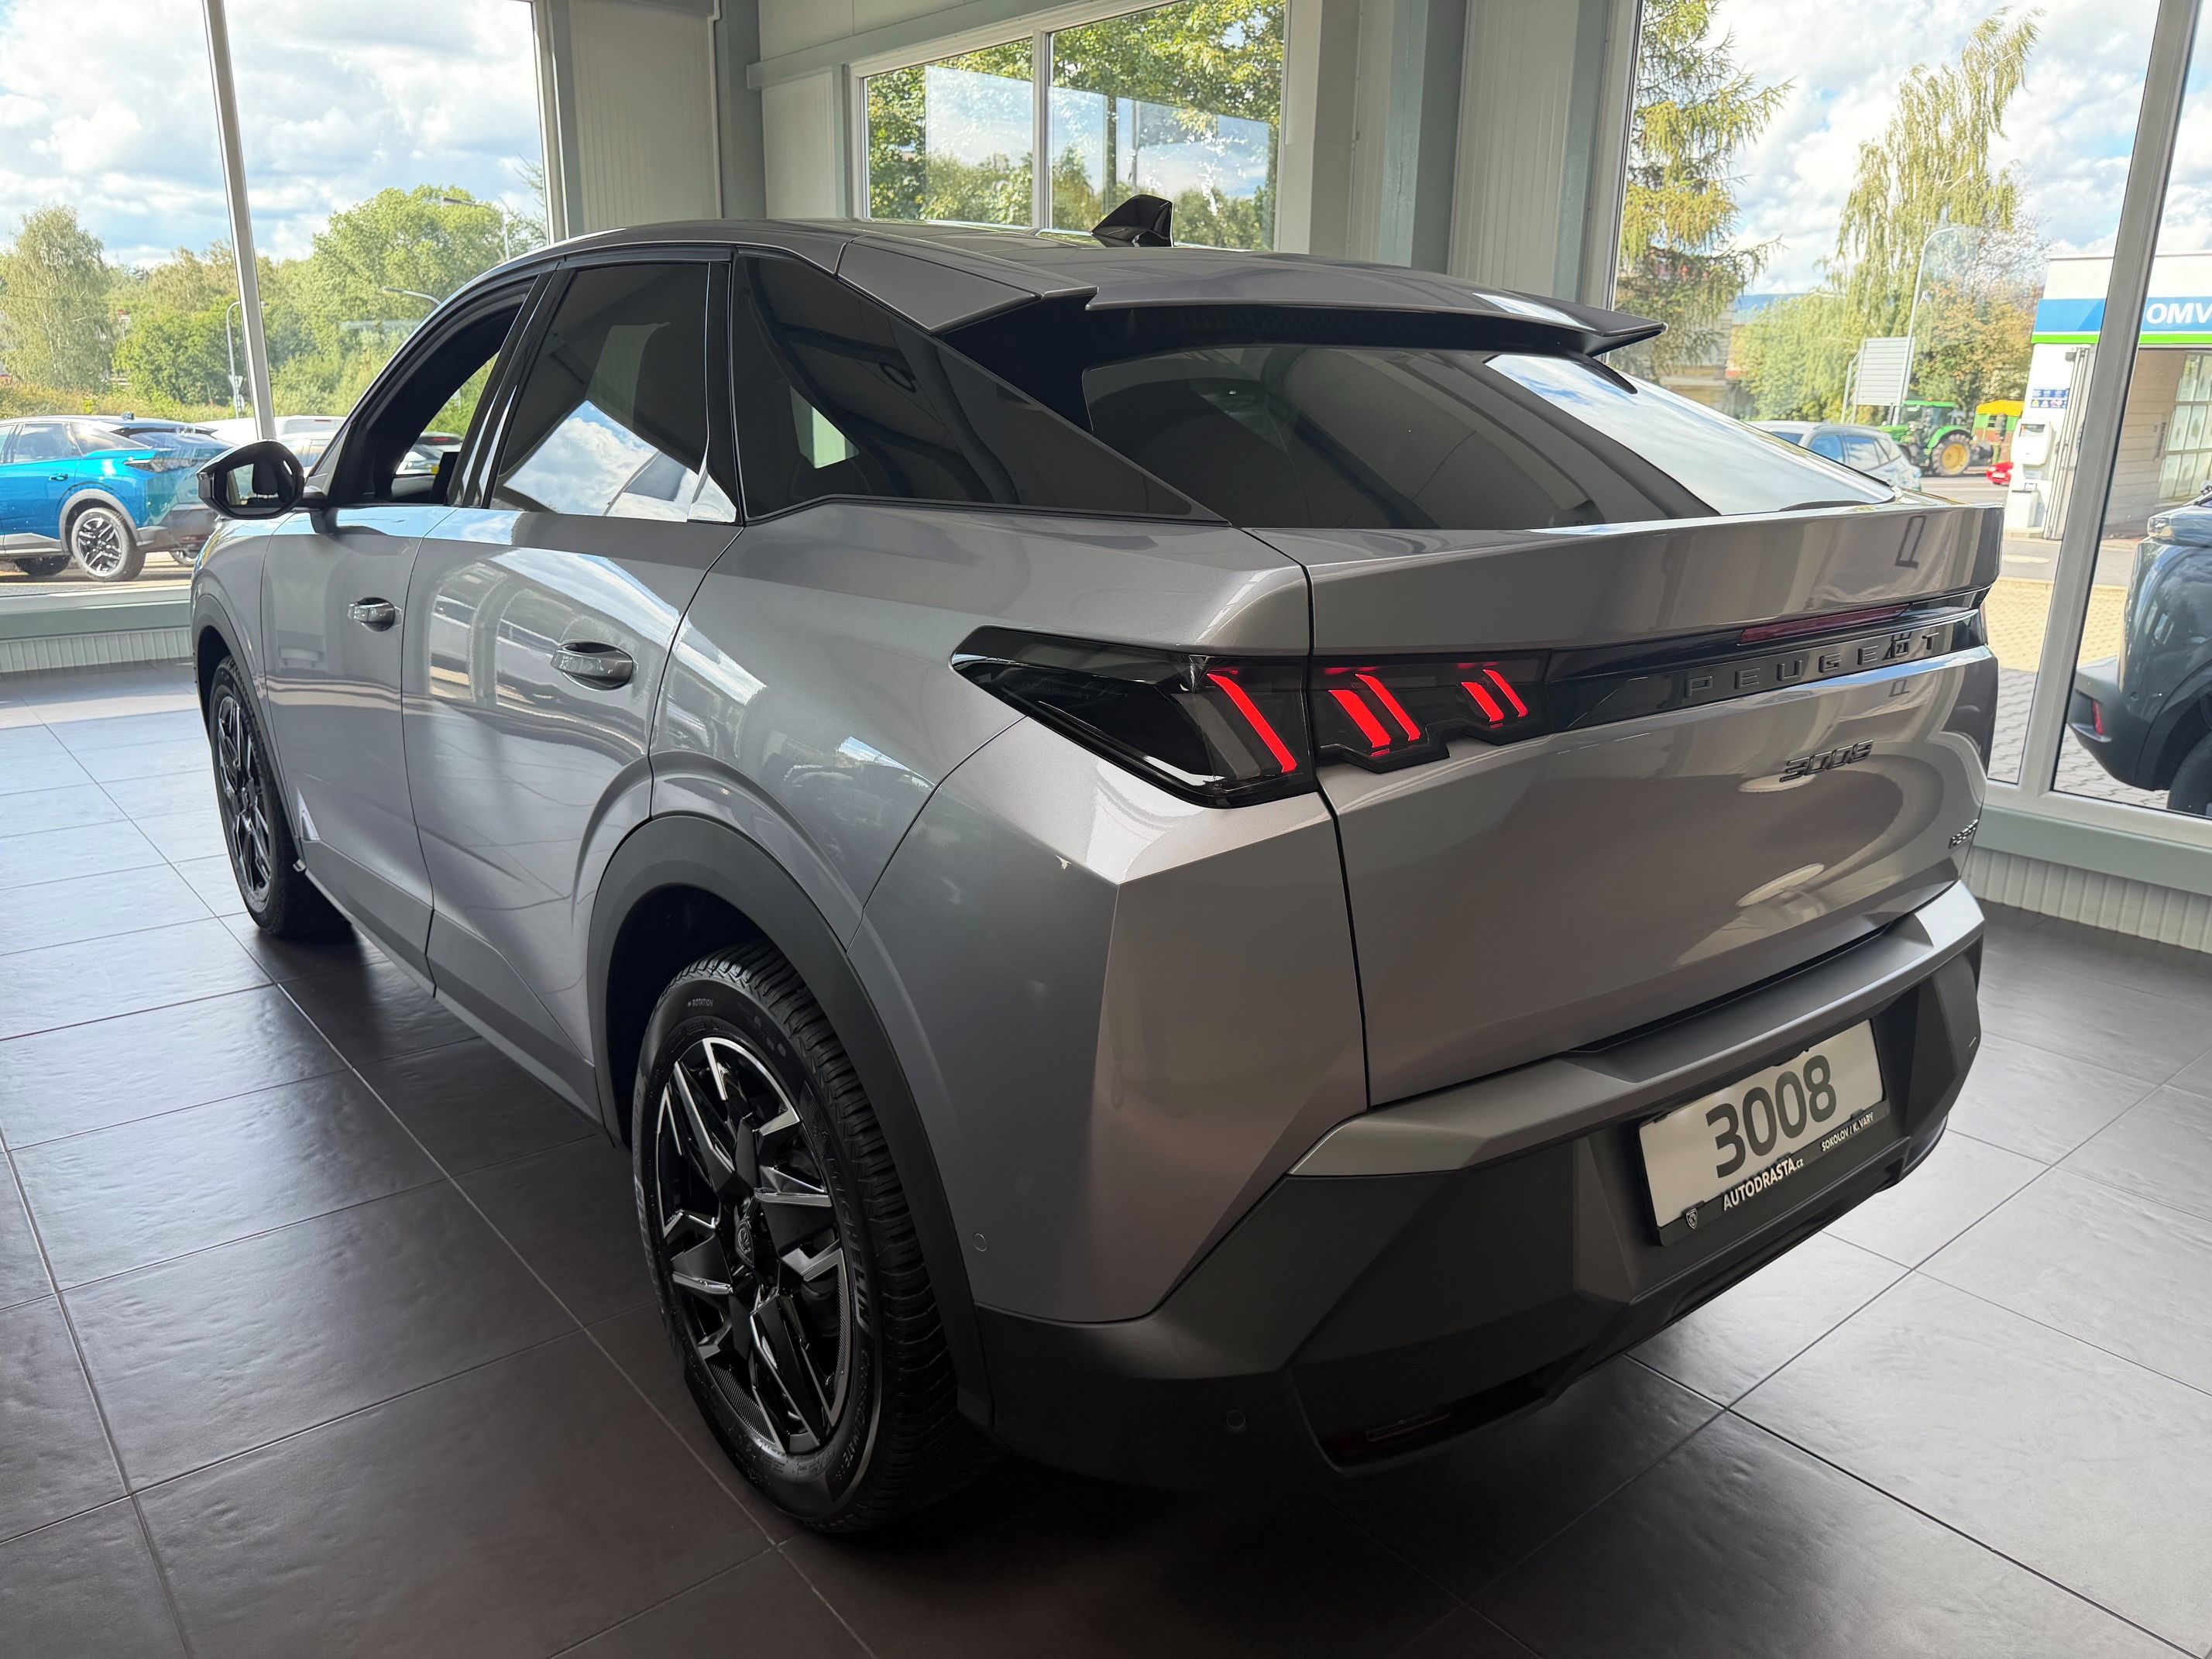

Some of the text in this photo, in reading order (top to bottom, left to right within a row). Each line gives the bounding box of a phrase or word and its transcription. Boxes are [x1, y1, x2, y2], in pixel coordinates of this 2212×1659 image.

[2145, 302, 2212, 325] OMV
[1686, 632, 1939, 698] PEUGEOT
[1779, 739, 1874, 782] 3008
[1705, 1055, 1836, 1178] 3008
[1821, 1127, 1849, 1152] SOKOLOV
[1859, 1111, 1874, 1128] VARY
[1724, 1158, 1804, 1211] AUTODRASTA.cz
